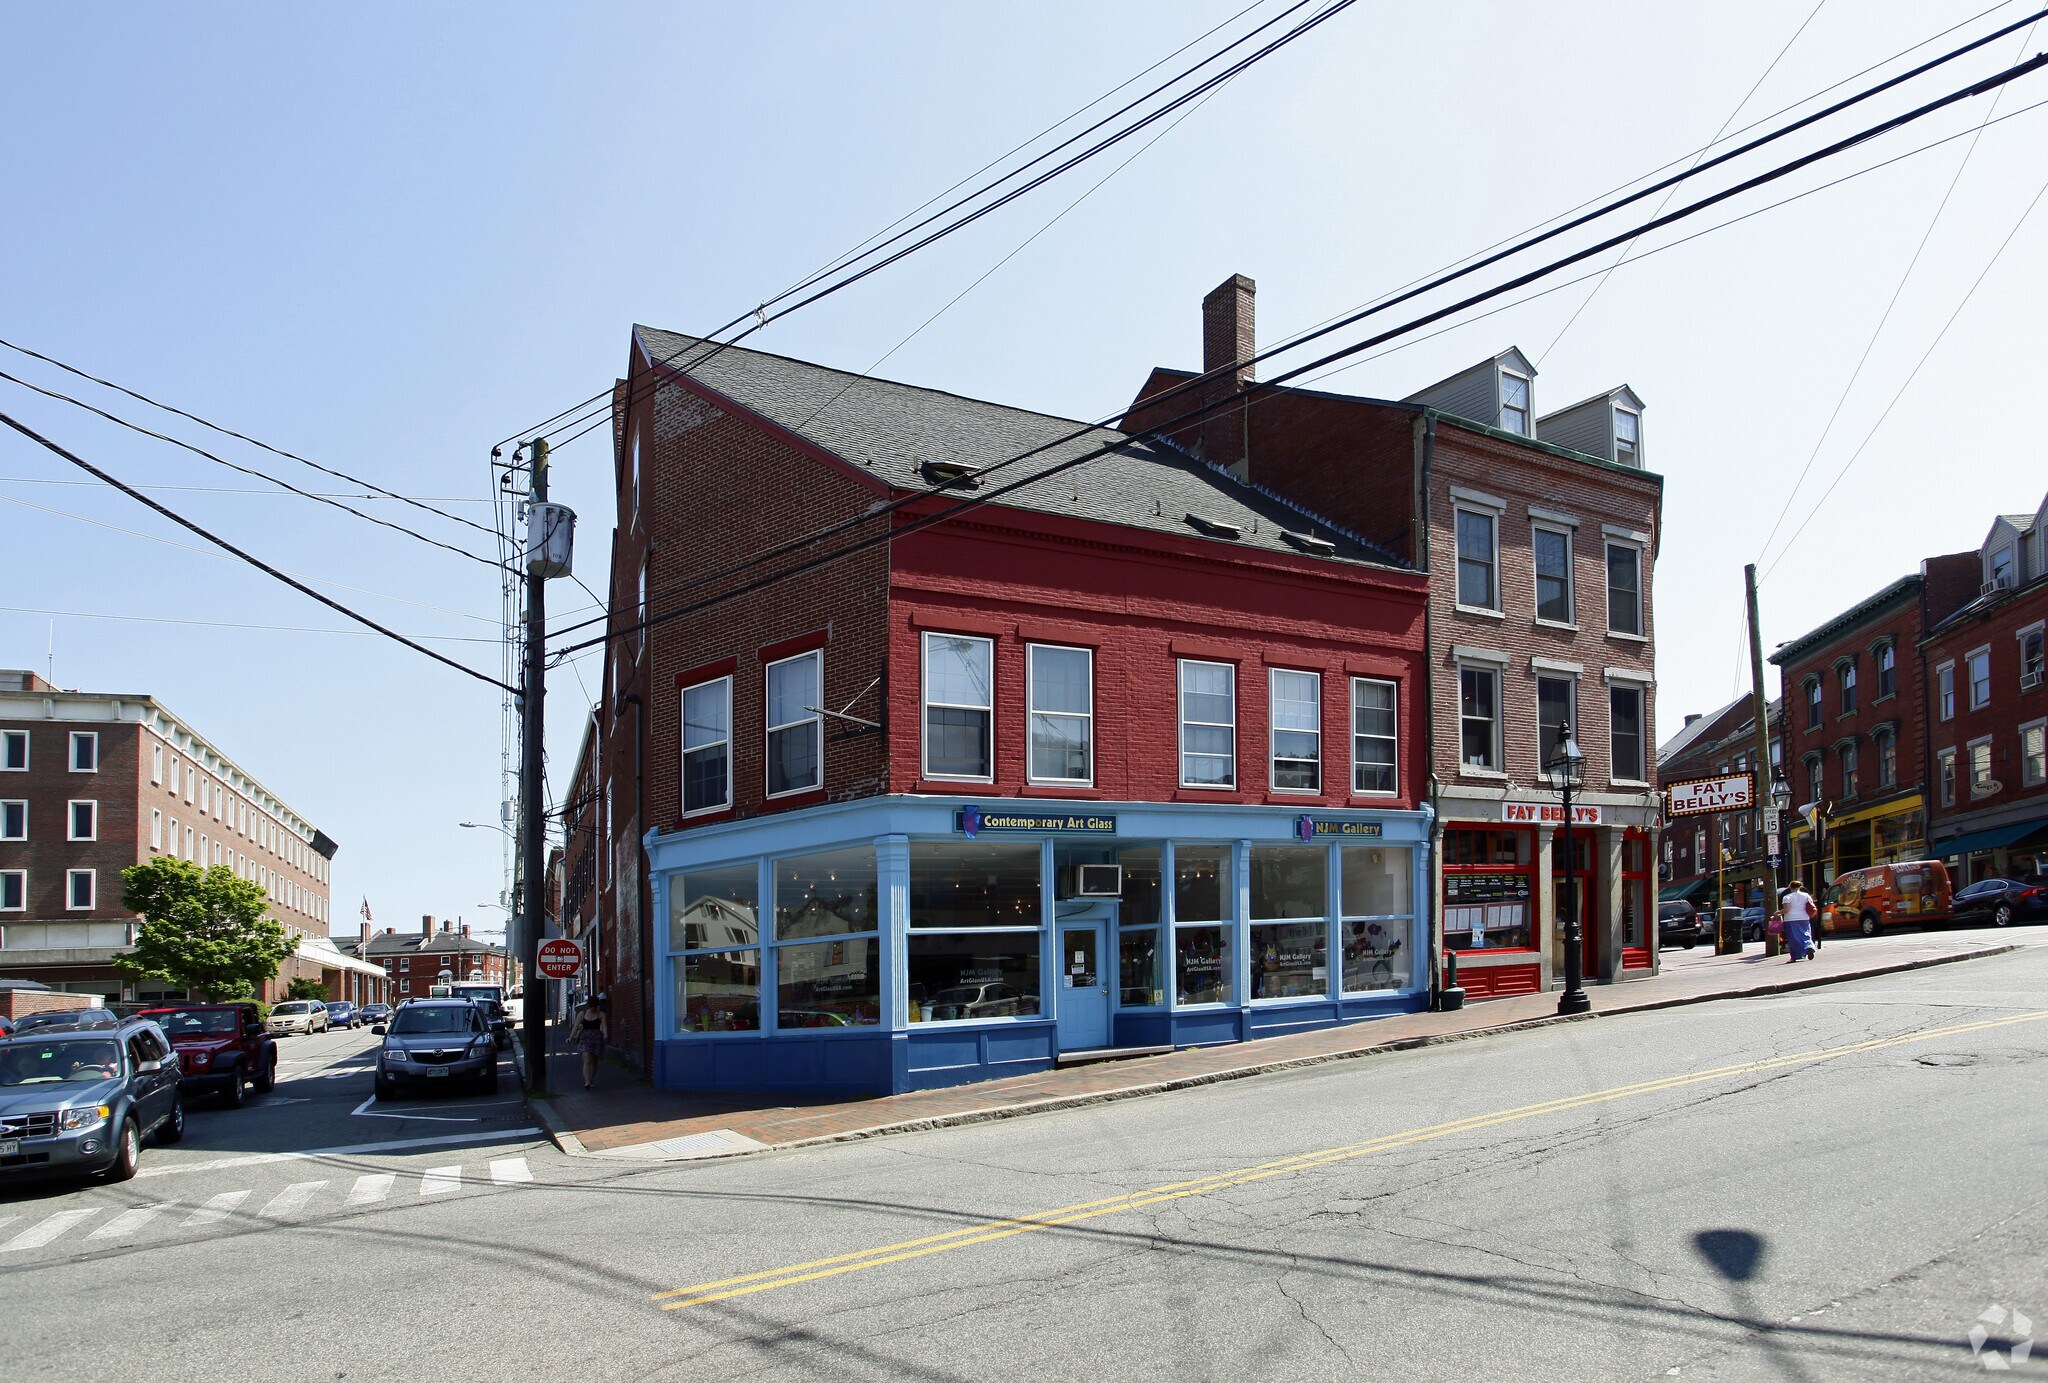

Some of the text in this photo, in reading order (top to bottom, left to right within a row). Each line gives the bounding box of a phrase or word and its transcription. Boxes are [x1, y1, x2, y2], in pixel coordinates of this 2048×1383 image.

[1693, 781, 1726, 795] FAT
[1673, 791, 1747, 811] BELLY'S
[1507, 805, 1599, 823] FAT BELY'S
[984, 814, 1113, 830] Contemporary Art Glass
[1315, 822, 1380, 836] NJM Gallery
[1767, 820, 1778, 831] 15
[7, 1144, 16, 1152] HY
